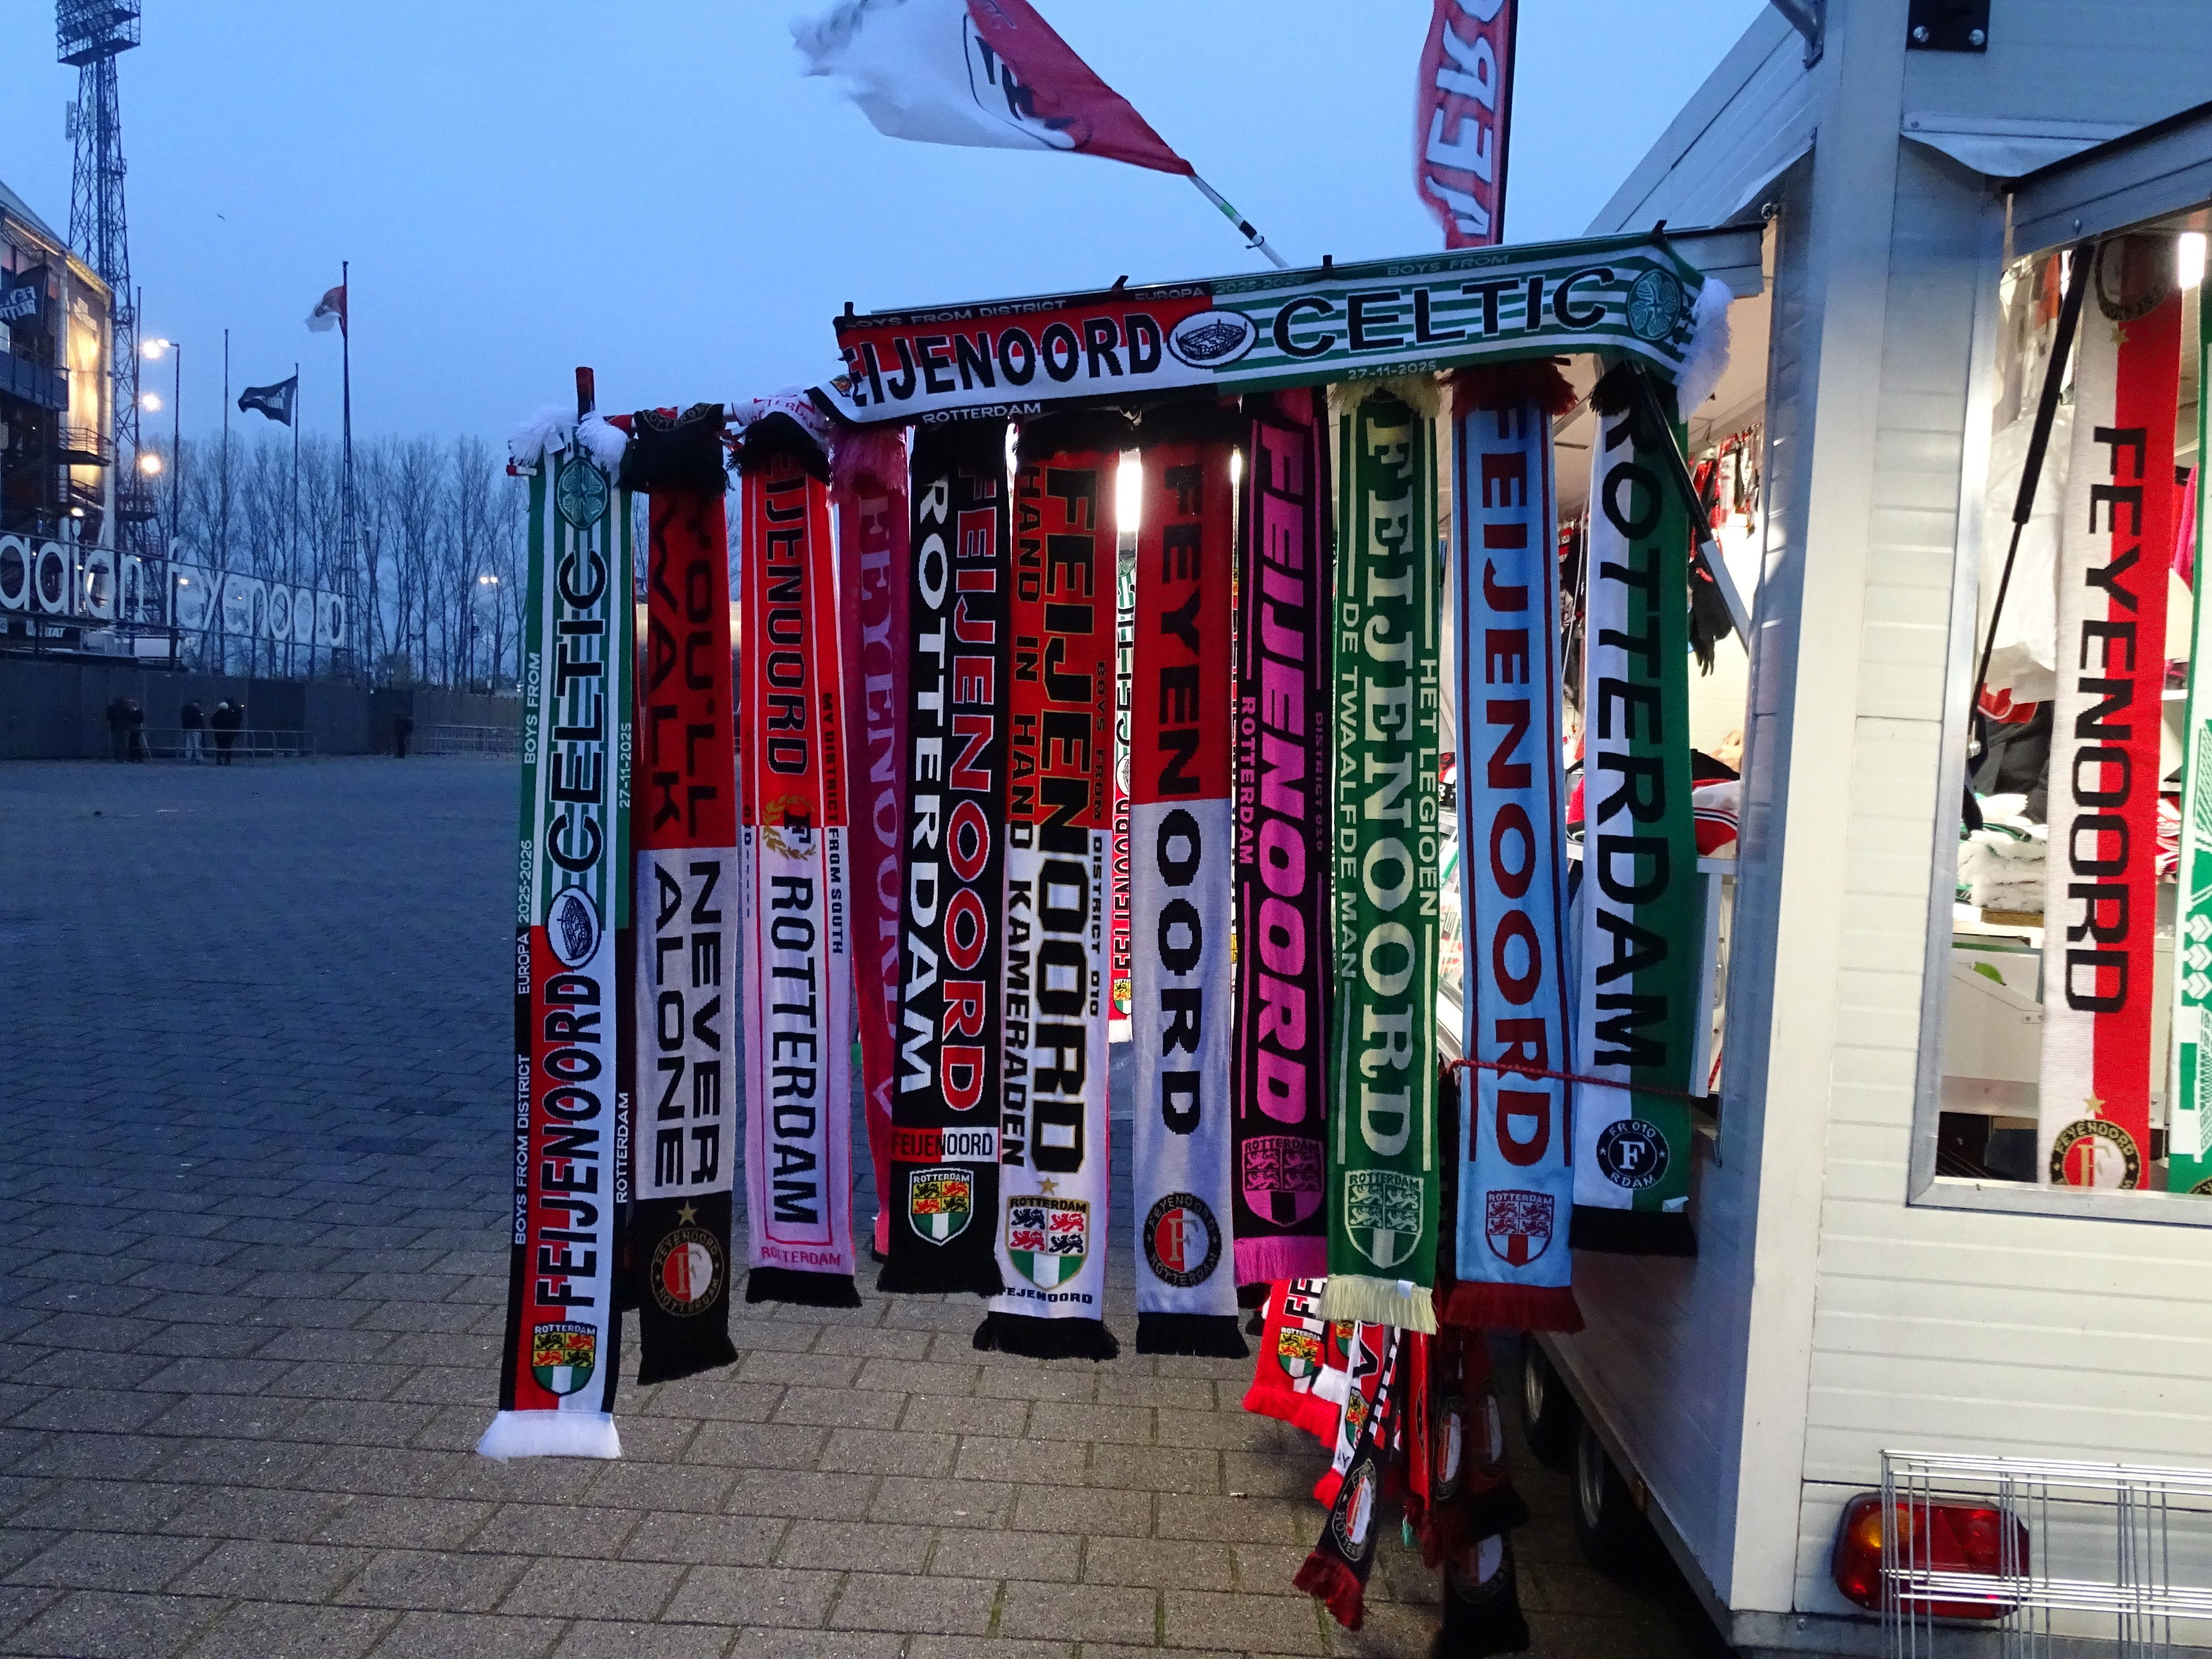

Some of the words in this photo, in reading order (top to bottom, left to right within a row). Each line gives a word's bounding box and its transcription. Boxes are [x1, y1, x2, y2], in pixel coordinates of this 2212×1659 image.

[1135, 286, 1206, 301] EUROPA
[1387, 262, 1441, 276] BOYS
[1449, 254, 1509, 270] FROM
[845, 316, 902, 328] OYS
[911, 311, 972, 324] FROM
[980, 300, 1066, 317] DISTRICT
[1273, 267, 1615, 359] CELTIC
[1348, 361, 1437, 380] 27-11-2025
[922, 402, 1042, 425] ROTTERDAM
[1017, 466, 1042, 603] HAND
[1014, 634, 1039, 683] IN
[1342, 602, 1360, 654] DE
[527, 652, 541, 709] FROM
[651, 500, 681, 833] WALK
[1096, 660, 1106, 730] BOYS
[1420, 659, 1438, 733] HET
[524, 713, 538, 765] BOYS
[546, 550, 608, 873] CELTIC
[822, 693, 834, 723] MY
[2065, 426, 2147, 1013] FEYENOORD
[619, 722, 632, 809] 27-11-2025
[824, 731, 838, 824] DISTRICT
[900, 473, 949, 1093] ROTTERDAM
[1010, 713, 1037, 850] HAND
[1093, 749, 1104, 821] FROM
[1239, 696, 1257, 864] ROTTERDAM
[1257, 423, 1306, 1124] FEIJENOORD
[1315, 712, 1323, 809] DISTRICT
[1340, 665, 1358, 879] TWAALFDE
[1359, 417, 1415, 1157] FEIJENOORD
[1030, 467, 1097, 1173] FEIJENOORD
[1156, 464, 1203, 1135] FEYENOORD
[829, 828, 841, 883] FROM
[1418, 747, 1438, 917] LEGIOEN
[517, 840, 533, 924] 2025-2026
[1090, 835, 1103, 955] DISTRICT
[831, 888, 843, 954] SOUTH
[1341, 892, 1357, 978] MAN
[517, 931, 530, 995] EUROPA
[1089, 970, 1100, 1016] 010
[655, 862, 684, 1187] ALONE
[690, 861, 721, 1185] NEVER
[771, 876, 818, 1225] ROTTERDAM
[1001, 880, 1032, 1167] KAMERADEN
[517, 1054, 531, 1129] DISTRICT
[516, 1134, 529, 1188] FROM
[535, 972, 602, 1307] FEIJENOORD
[616, 1092, 629, 1204] ROTTERDAM
[892, 1132, 993, 1157] FEIJENOORD
[1244, 1138, 1320, 1153] ROTTERDAM
[1608, 1123, 1627, 1138] FR
[1632, 1121, 1656, 1138] 010
[1619, 1141, 1645, 1170] F
[2054, 1120, 2135, 1158] FEYENOORD
[914, 1172, 970, 1184] ROTTERDAM
[1009, 1197, 1087, 1213] ROTTERDAM
[1348, 1173, 1420, 1190] ROTTERDAM
[1487, 1194, 1553, 1206] ROTTERDAM
[1610, 1173, 1656, 1189] RDAM
[515, 1194, 527, 1245] BOYS
[1148, 1194, 1215, 1231] FEYENOORD
[657, 1231, 719, 1264] FEYENOORD
[761, 1247, 841, 1266] ROTTERDAM
[1150, 1252, 1217, 1286] ROTTERDAM
[659, 1278, 719, 1312] ROTTERDAM
[1004, 1286, 1093, 1304] EJENOORD
[534, 1324, 596, 1336] ROTTERDAM
